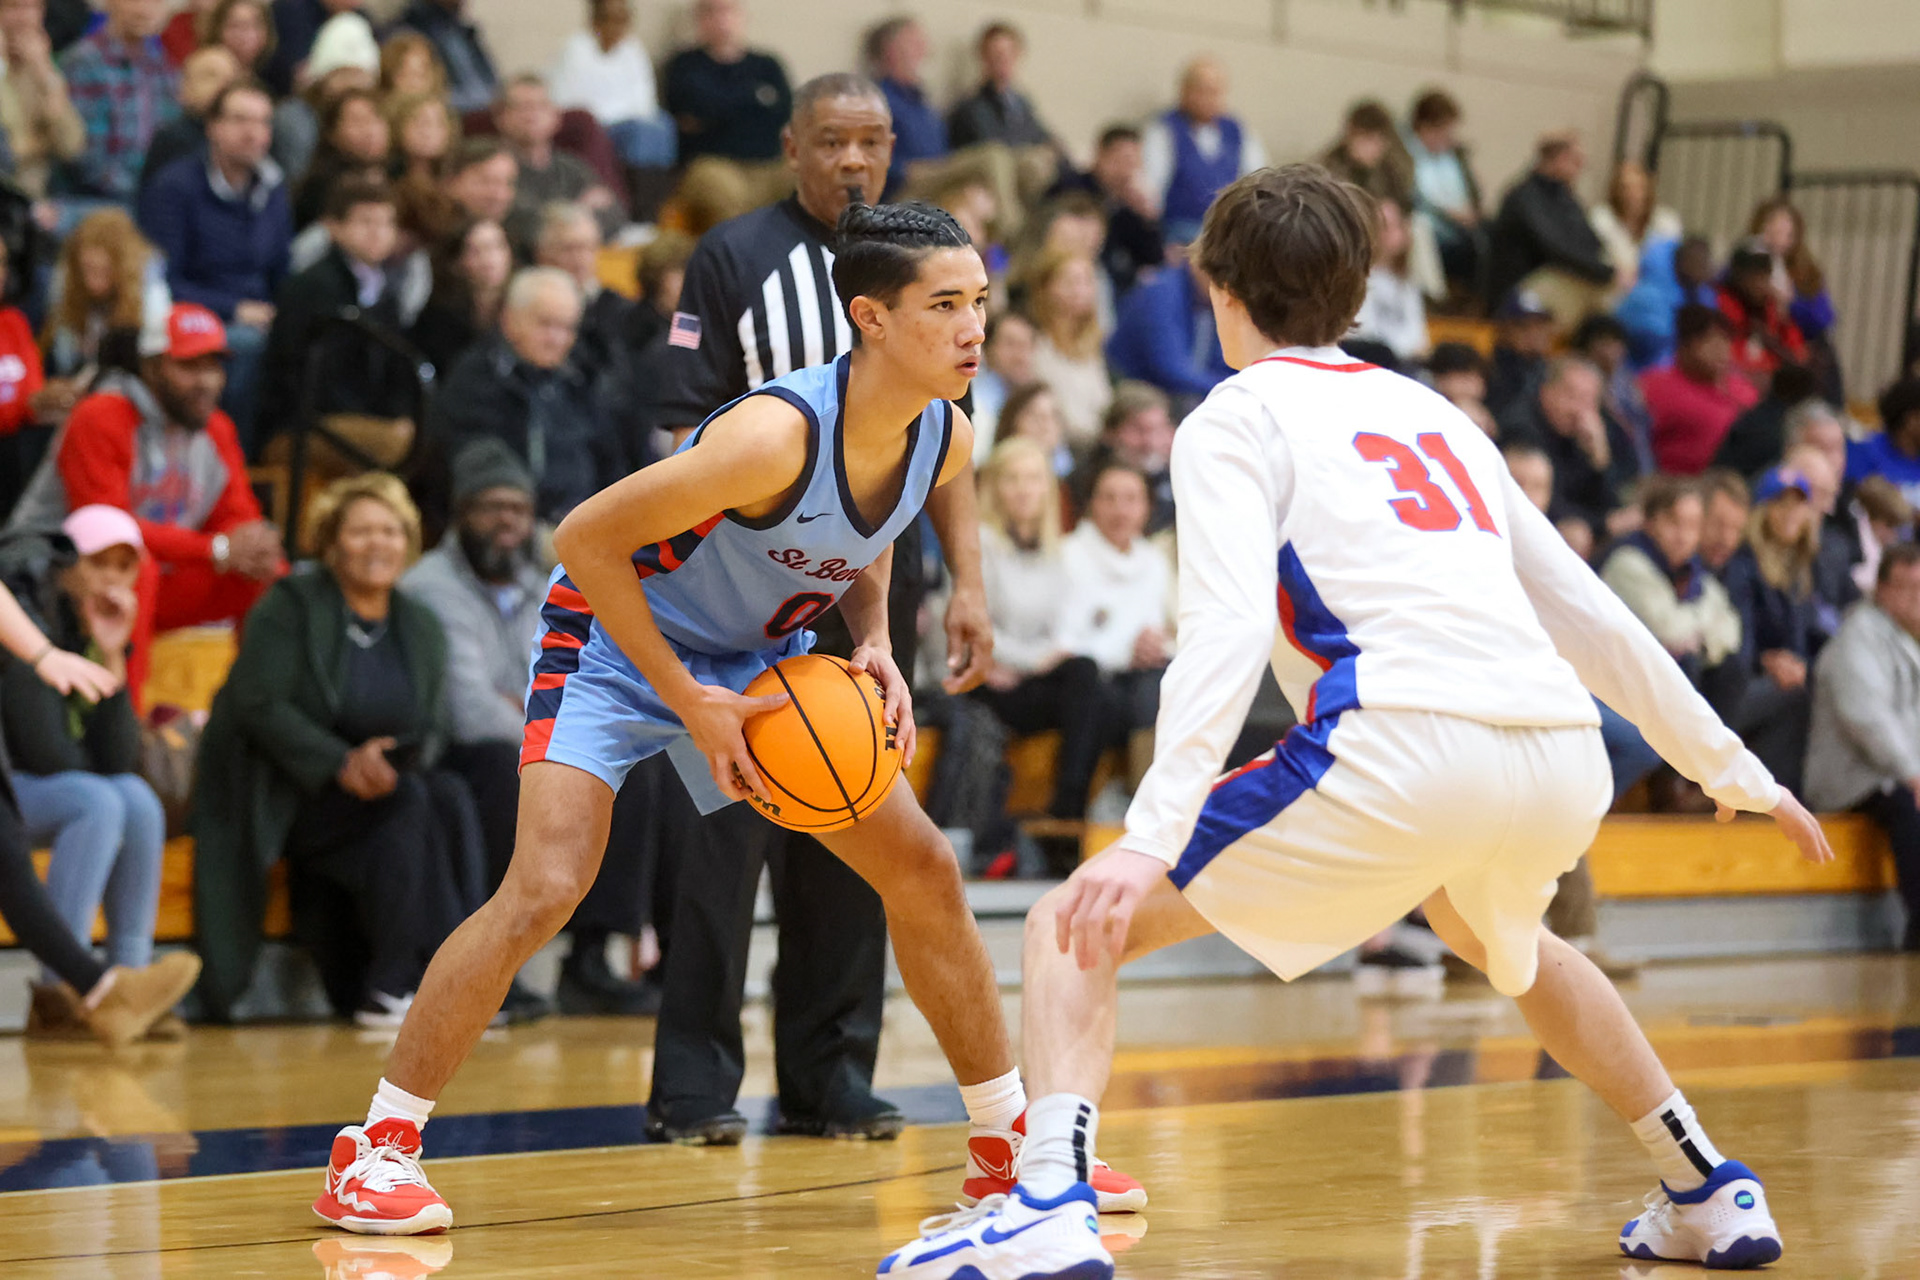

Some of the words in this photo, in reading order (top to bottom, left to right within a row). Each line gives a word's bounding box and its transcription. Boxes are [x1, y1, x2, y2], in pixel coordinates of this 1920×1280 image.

[1352, 431, 1502, 538] 31
[767, 548, 812, 570] St
[763, 591, 835, 639] 0
